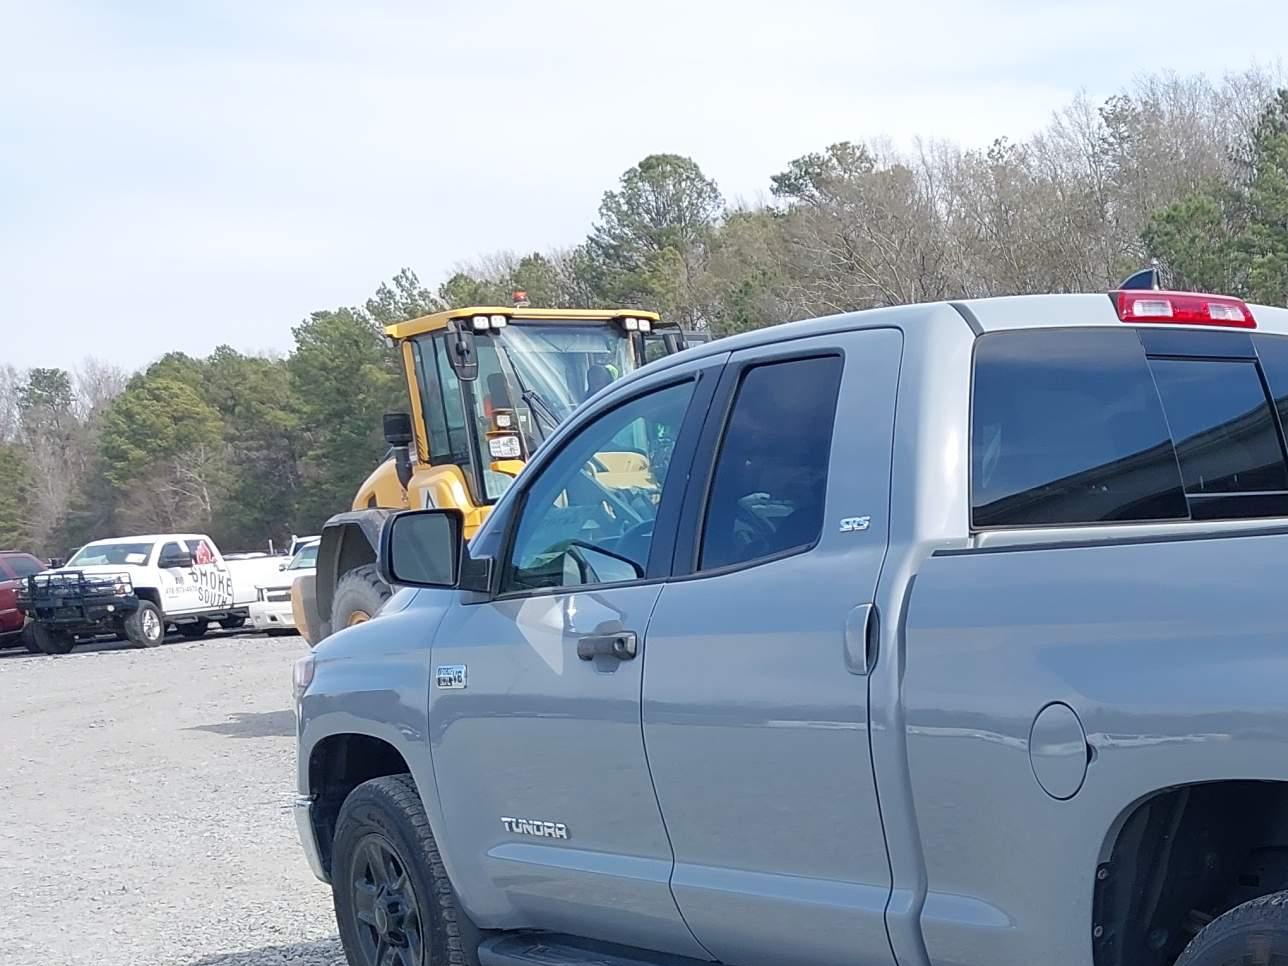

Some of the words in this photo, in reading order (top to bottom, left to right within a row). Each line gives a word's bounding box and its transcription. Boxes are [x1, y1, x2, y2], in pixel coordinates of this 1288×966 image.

[190, 565, 232, 597] SMOKE
[198, 587, 228, 609] SOUTH
[500, 816, 568, 839] TUNDRA
